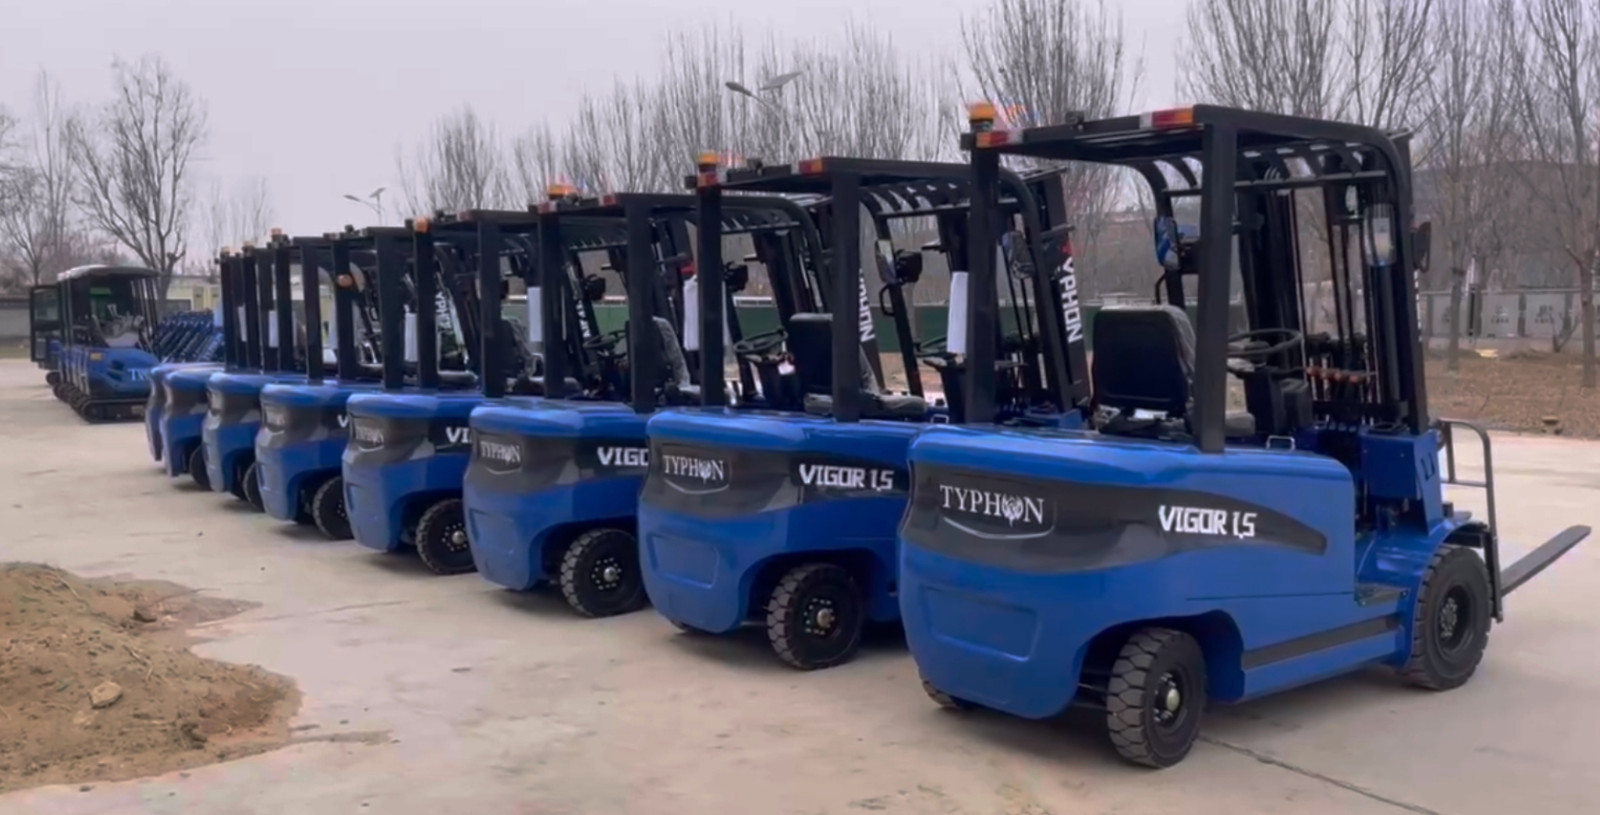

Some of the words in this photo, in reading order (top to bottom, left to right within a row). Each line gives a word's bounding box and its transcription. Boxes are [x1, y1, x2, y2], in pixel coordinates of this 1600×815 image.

[1060, 256, 1083, 343] YPHON
[662, 455, 725, 484] TYPHON
[799, 464, 865, 488] VIGOR
[939, 484, 1045, 525] TYPHON
[1158, 505, 1227, 535] VIGOR
